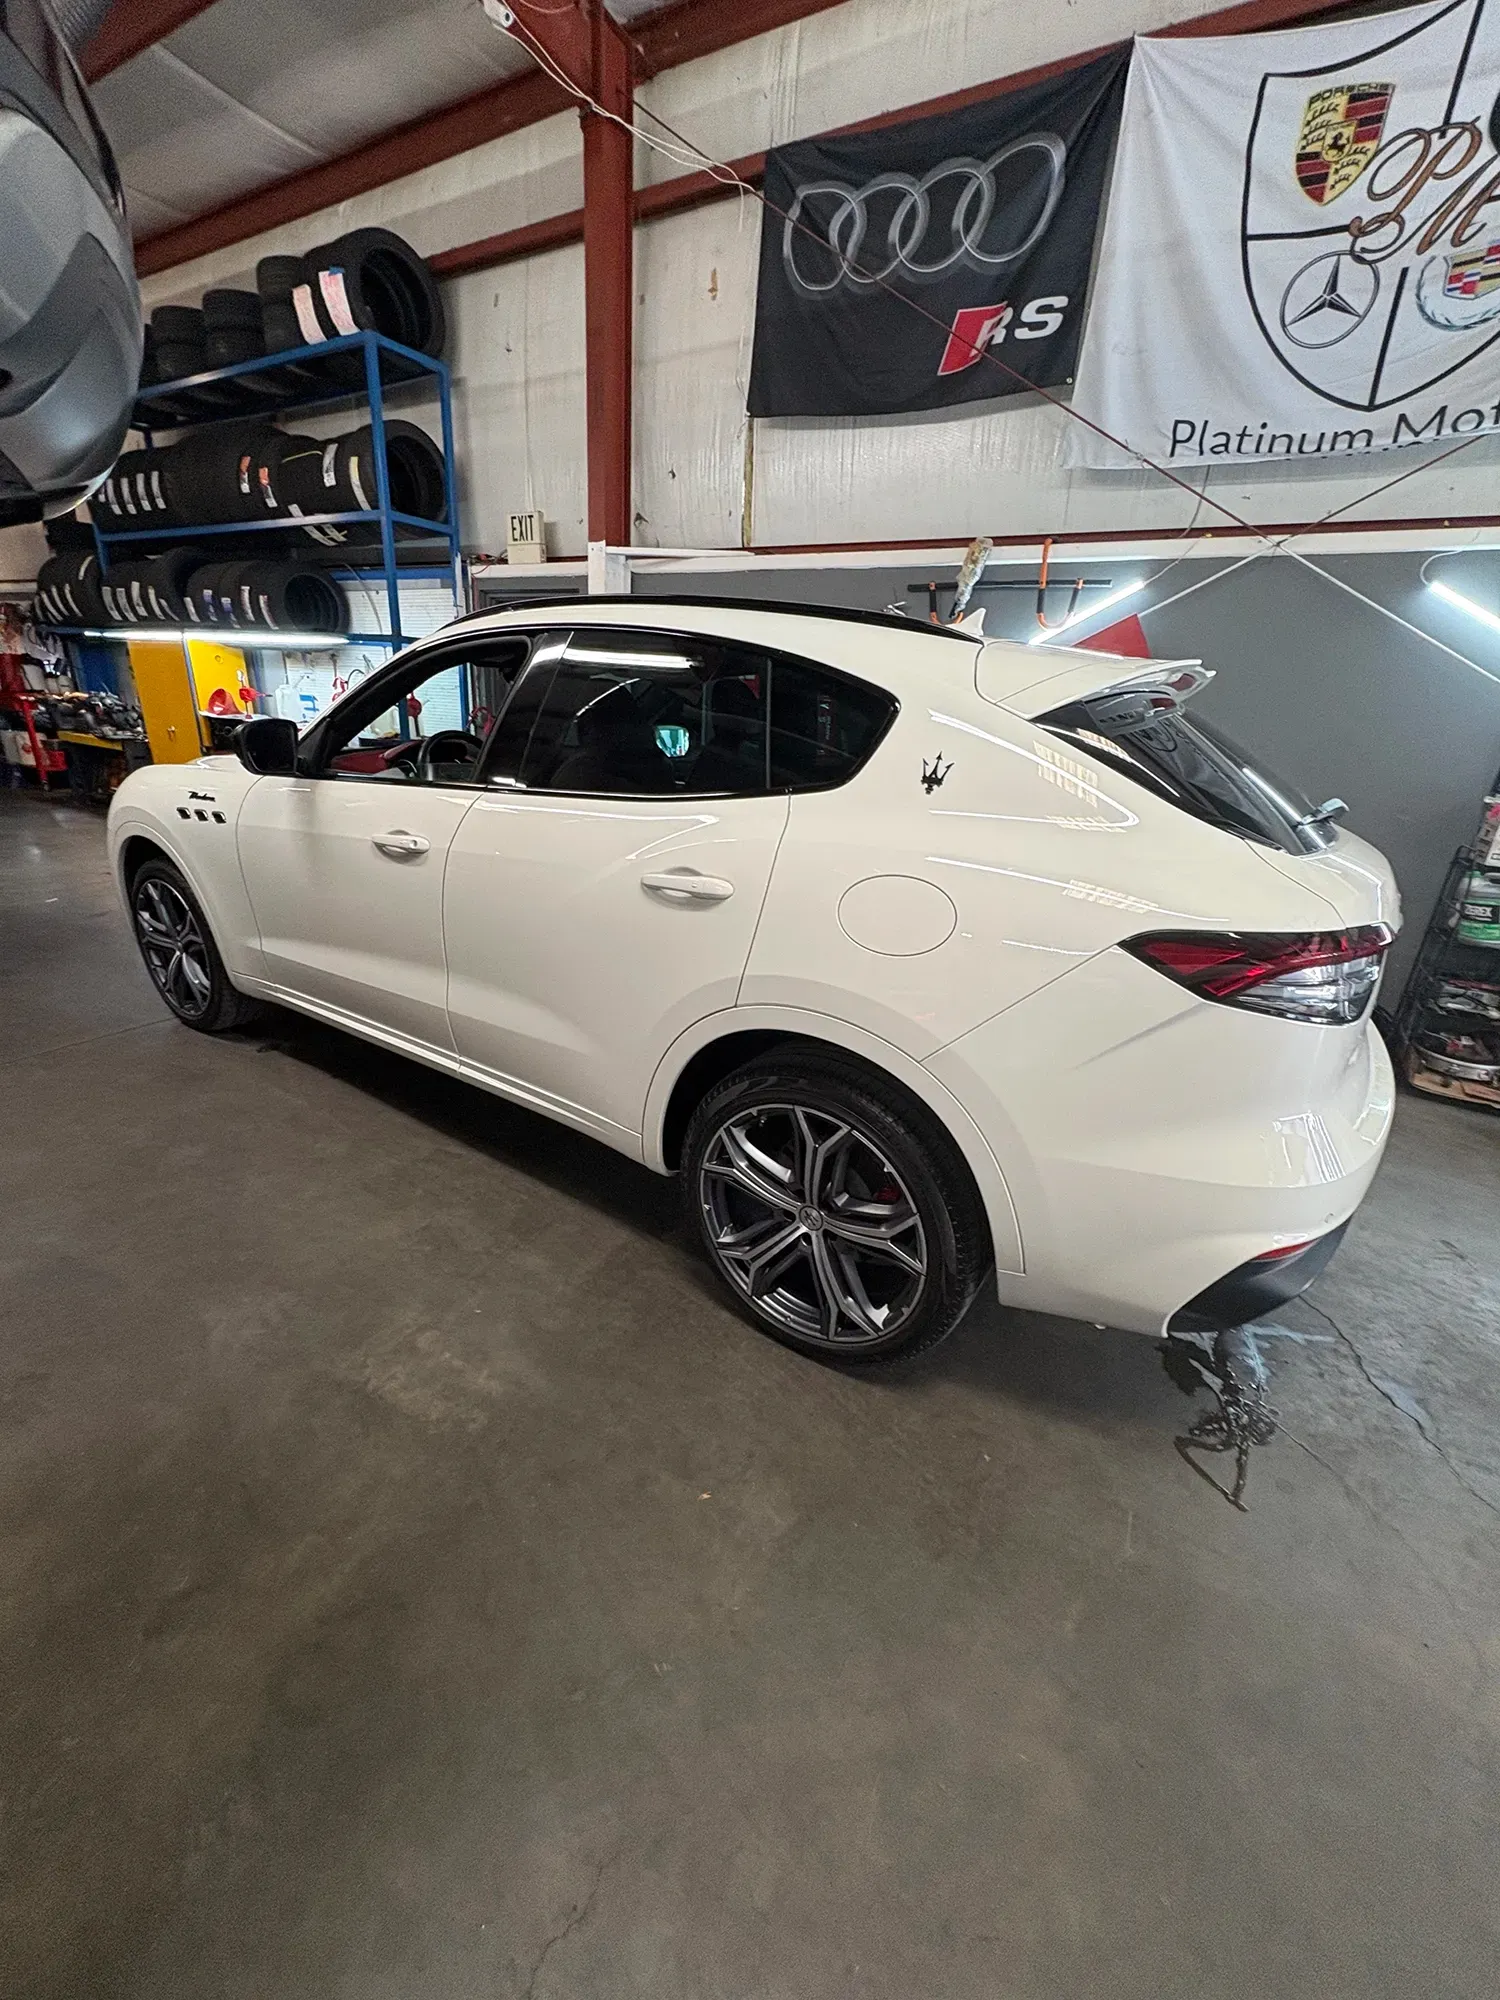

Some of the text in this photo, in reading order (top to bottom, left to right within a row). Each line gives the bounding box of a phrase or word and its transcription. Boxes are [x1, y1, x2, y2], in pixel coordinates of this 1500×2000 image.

[969, 295, 1069, 358] RS
[1168, 409, 1374, 458] Platinum
[510, 514, 534, 542] EXIT
